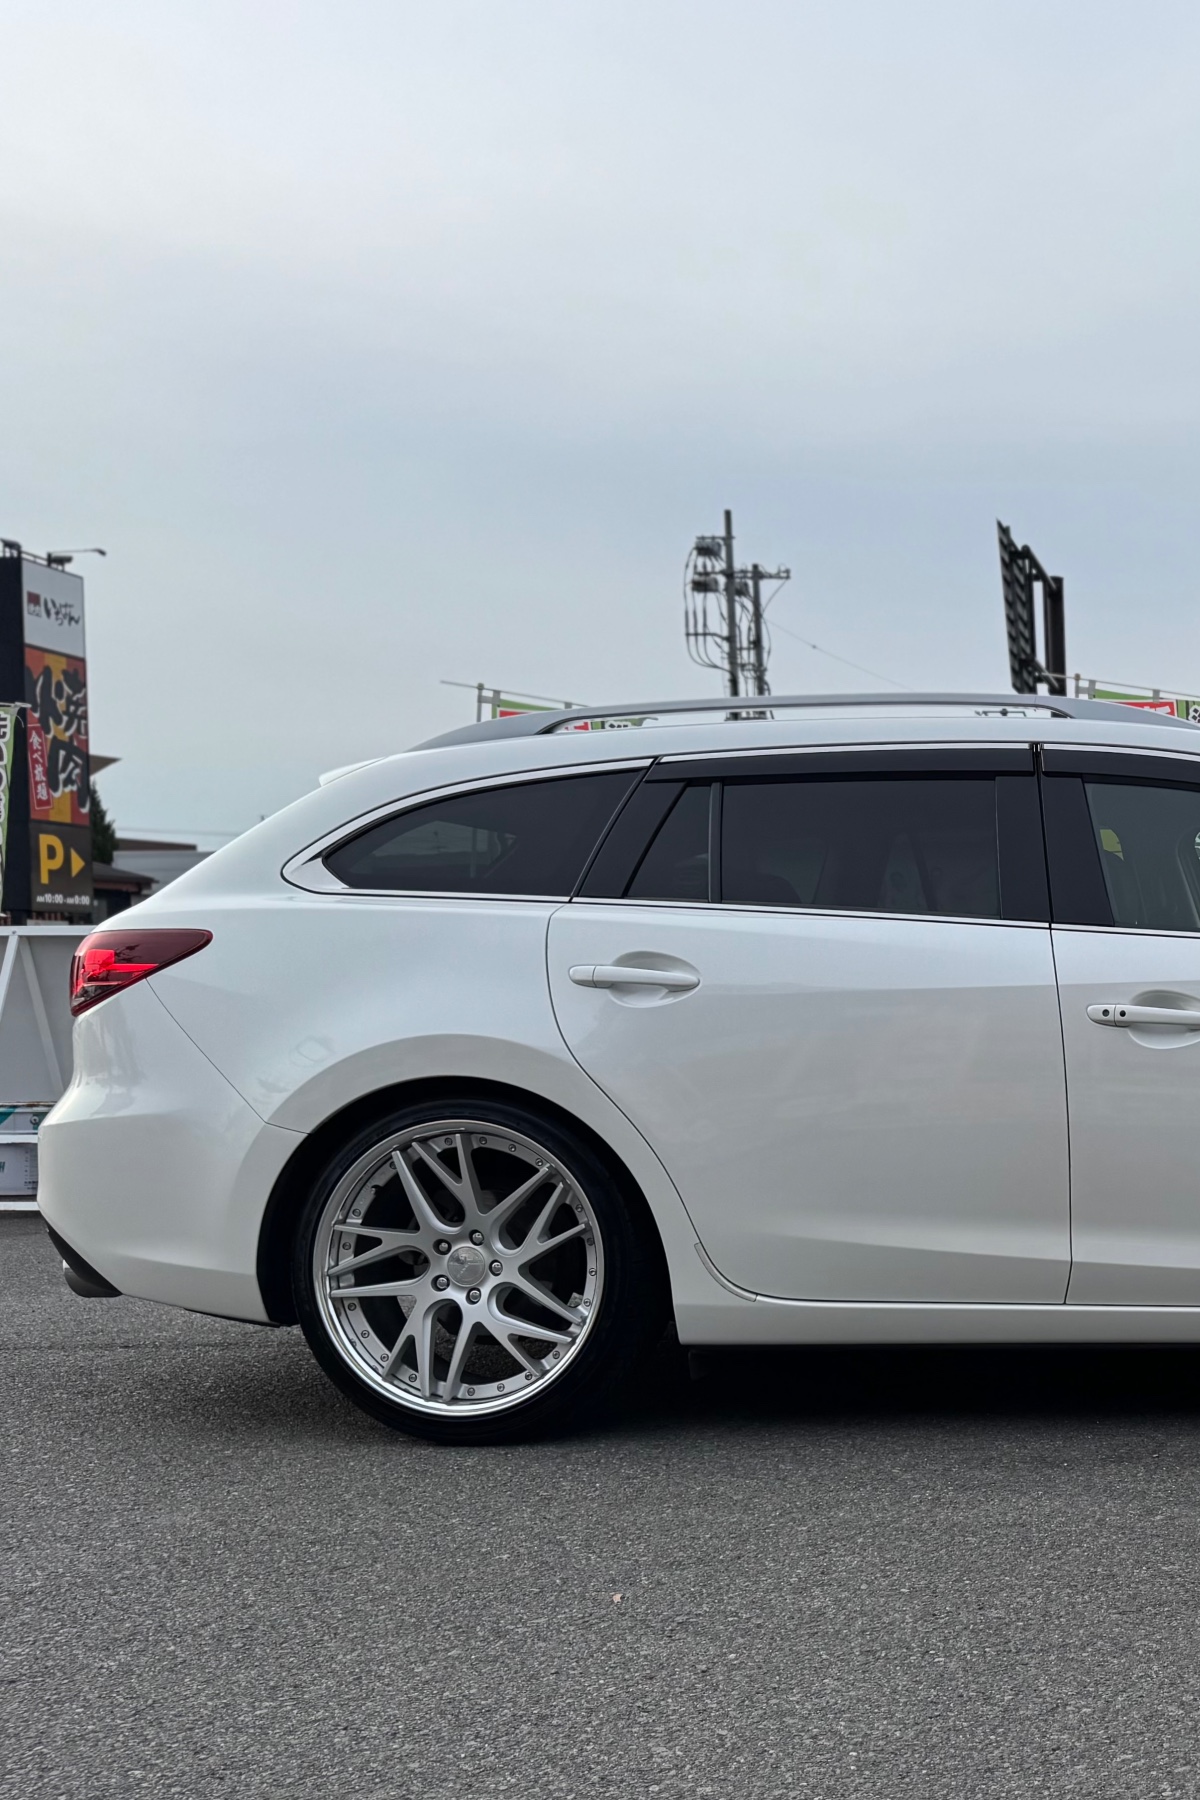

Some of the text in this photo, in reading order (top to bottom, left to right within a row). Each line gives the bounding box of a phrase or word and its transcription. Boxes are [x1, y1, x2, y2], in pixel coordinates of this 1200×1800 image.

[29, 729, 49, 801] 食べ放題
[39, 833, 64, 884] P
